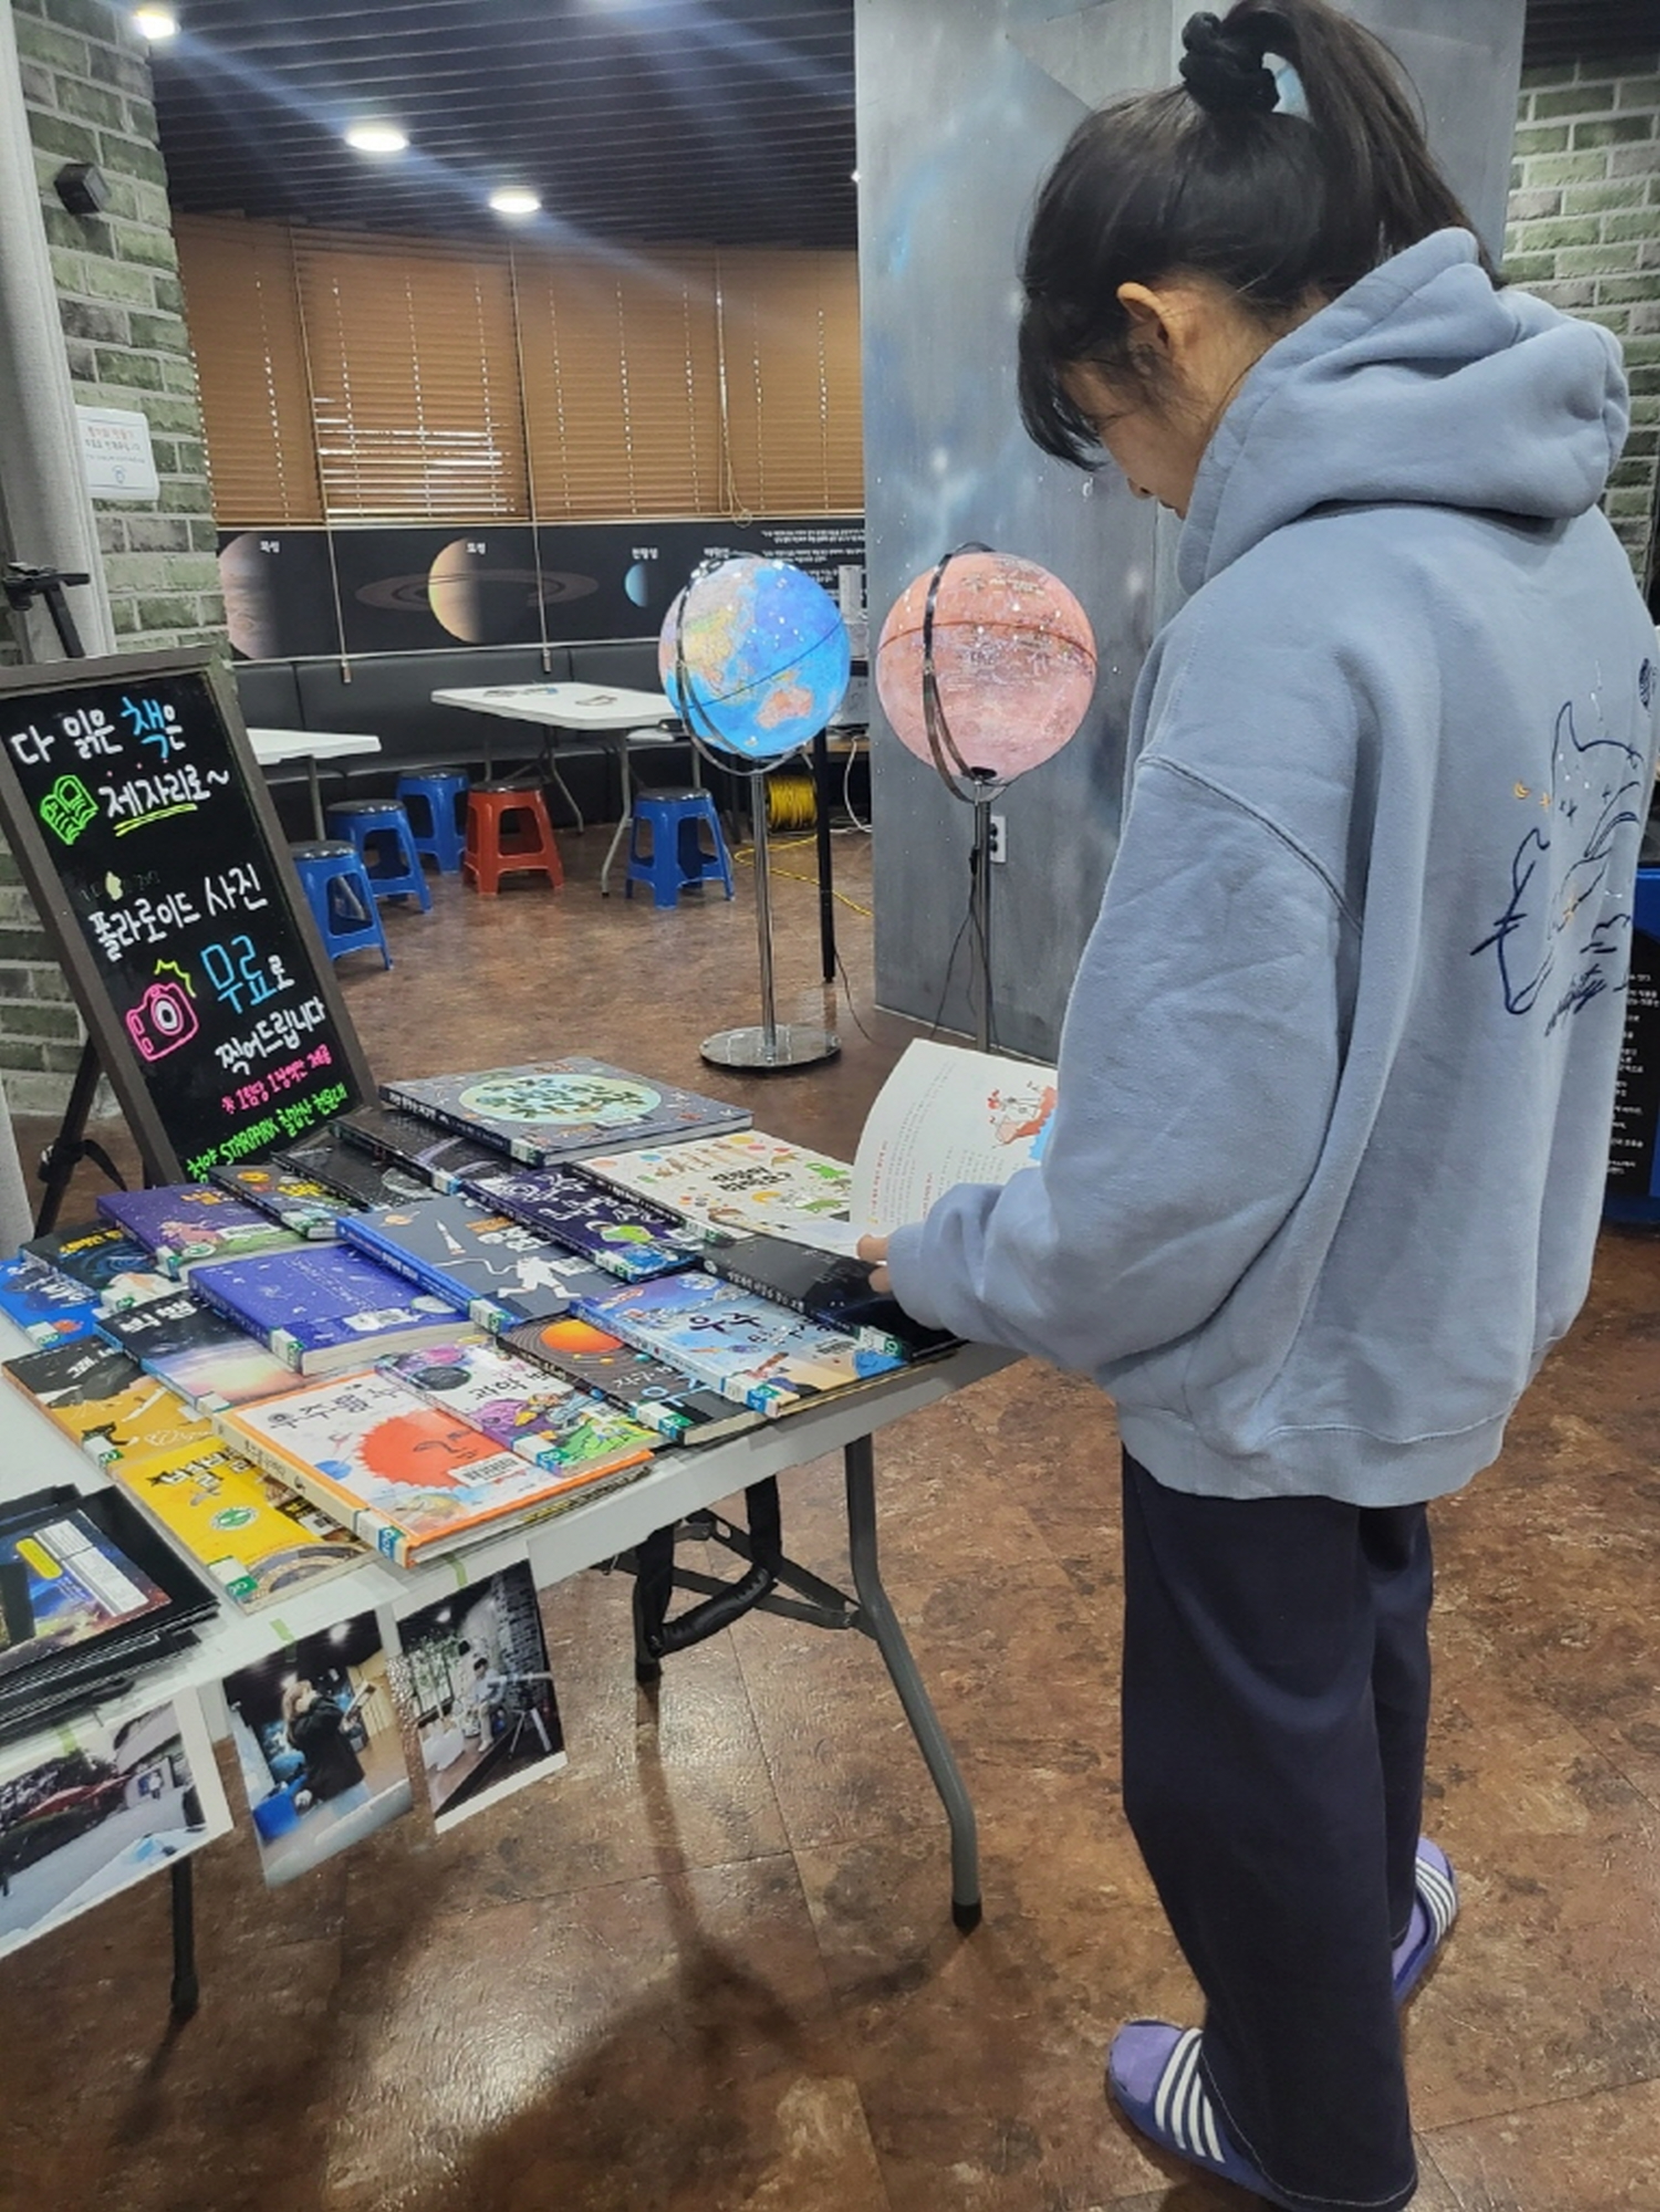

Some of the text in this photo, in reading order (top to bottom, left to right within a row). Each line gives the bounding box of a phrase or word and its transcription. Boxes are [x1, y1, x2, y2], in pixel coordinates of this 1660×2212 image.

[10, 696, 186, 764] 다 읽은 책은
[88, 893, 201, 962] 폴라로이드
[204, 863, 268, 915] 사진
[200, 935, 294, 1014] 무료로
[214, 995, 327, 1075] 찍어드립니다
